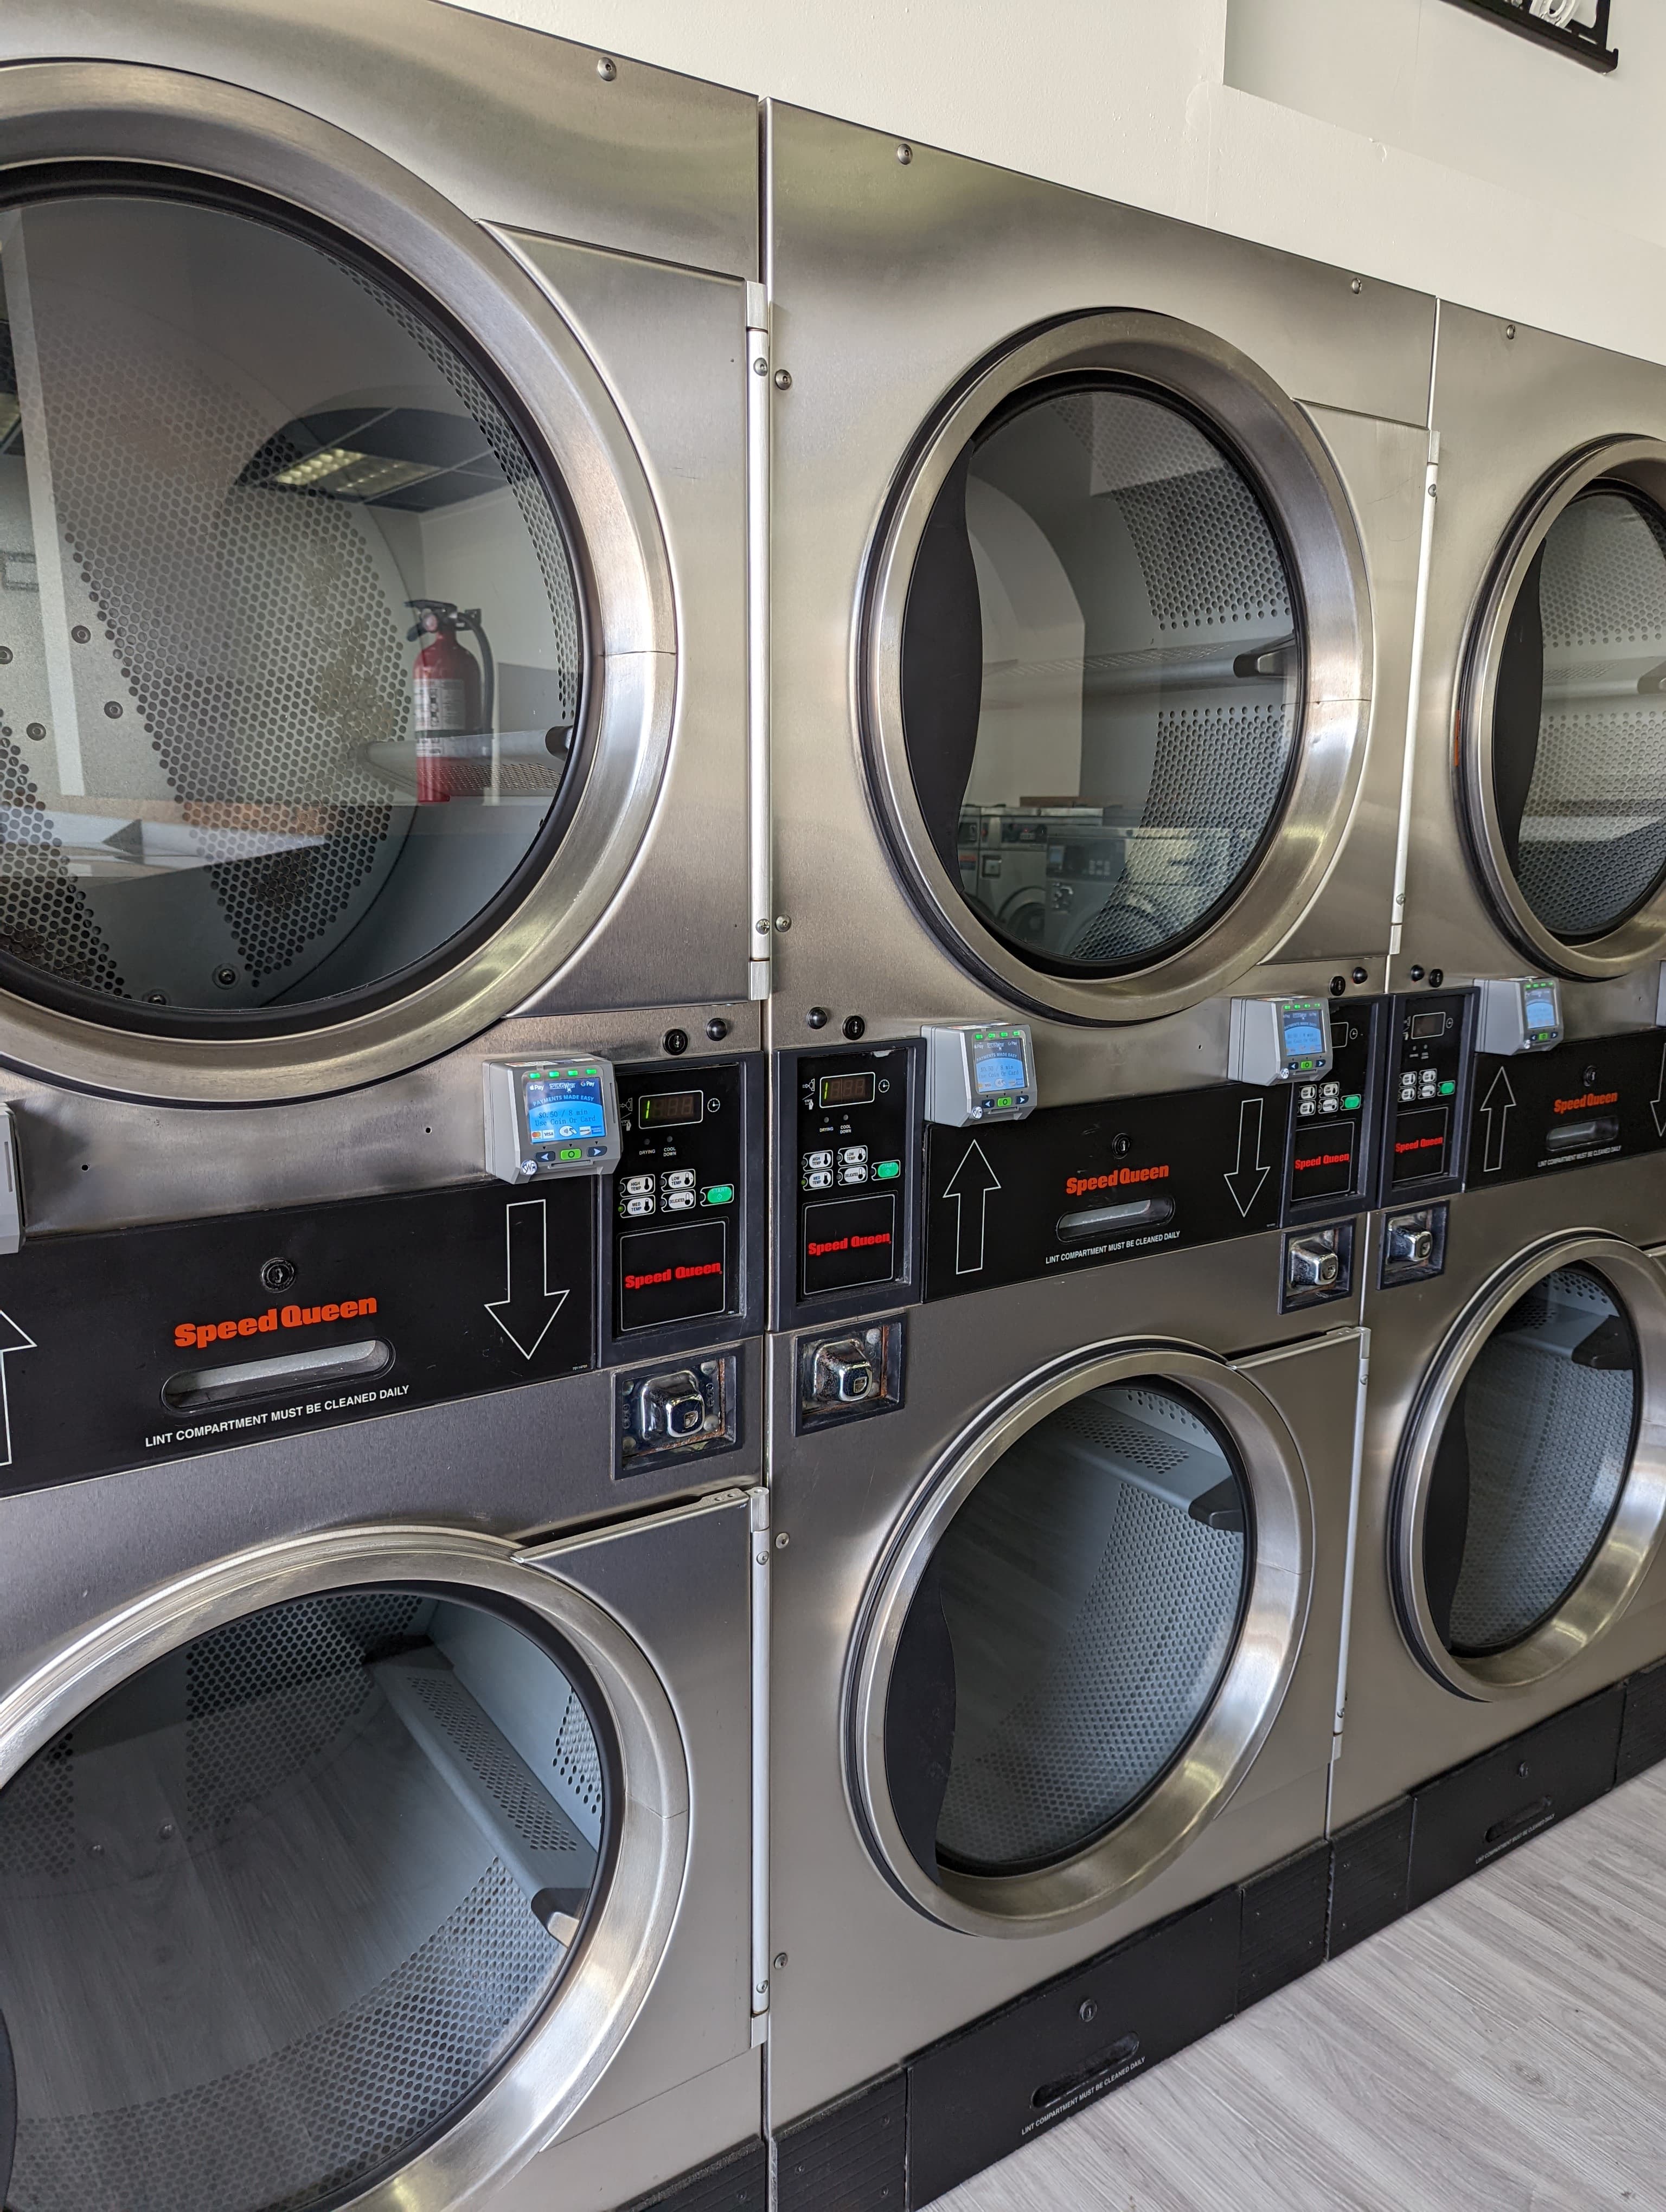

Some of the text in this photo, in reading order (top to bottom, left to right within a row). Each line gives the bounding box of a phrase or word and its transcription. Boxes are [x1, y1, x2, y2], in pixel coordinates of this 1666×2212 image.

[533, 1095, 562, 1107] PAYMENTS
[1554, 1092, 1618, 1114] Speed Queen
[1395, 1140, 1419, 1153] Speed
[1295, 1153, 1349, 1170] Speed Queen
[1066, 1165, 1169, 1195] Speed Queen
[808, 1233, 890, 1256] Speed Queen
[1045, 1231, 1181, 1264] LINT COMPARTMENT MUST BE CLEANED DAILY
[625, 1263, 721, 1289] Speed Queen
[174, 1297, 377, 1348] Speed Queen
[145, 1385, 409, 1447] LINT COMPARTMENT MUST BE CLEANED DAILY
[1021, 2123, 1035, 2136] LINT
[1035, 2097, 1078, 2127] COMPARTMENT
[1079, 2087, 1094, 2101] MUST
[1104, 2066, 1130, 2086] CLEANED
[1130, 2056, 1145, 2070] DAILY
